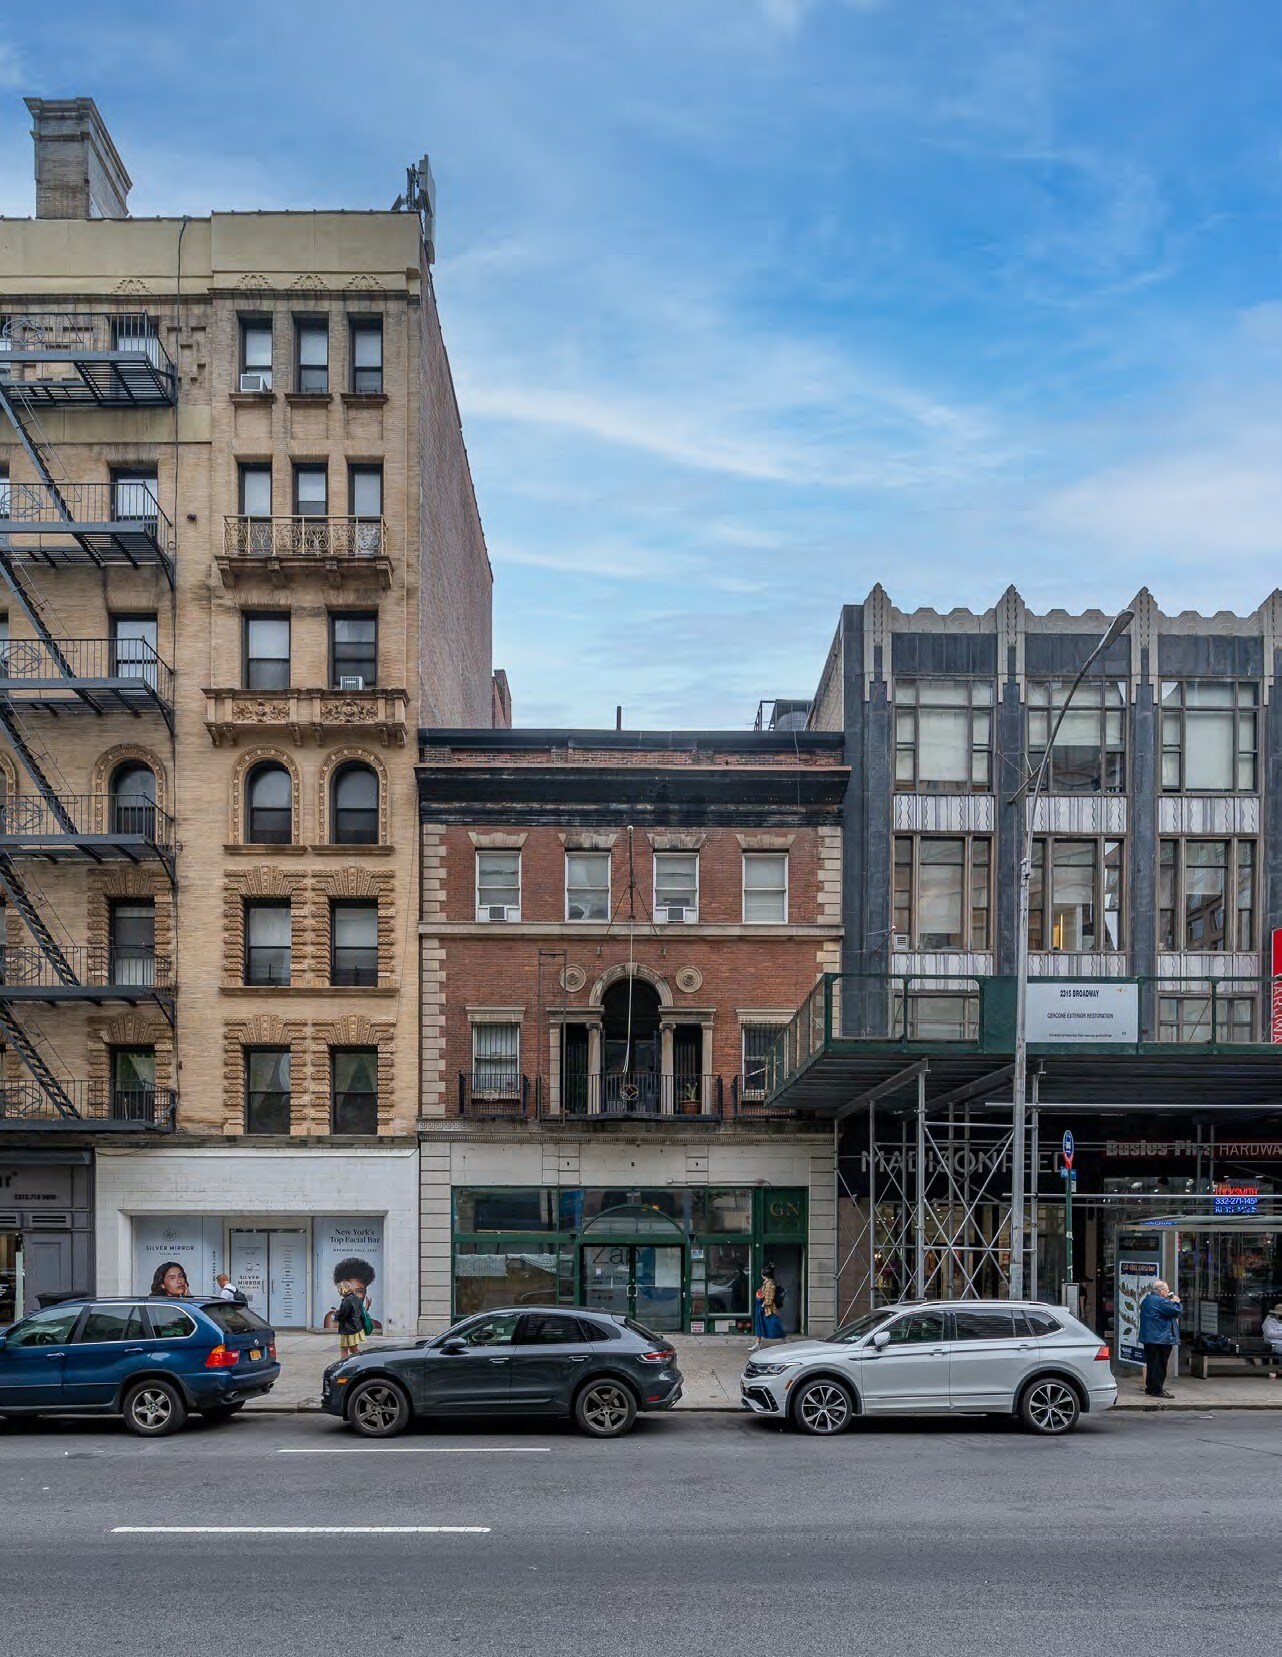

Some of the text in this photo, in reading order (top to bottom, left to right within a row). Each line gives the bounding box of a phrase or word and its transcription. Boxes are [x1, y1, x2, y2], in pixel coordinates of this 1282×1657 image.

[1060, 989, 1100, 998] 2315 BROADWAY
[329, 1236, 380, 1245] Top Facial Bar
